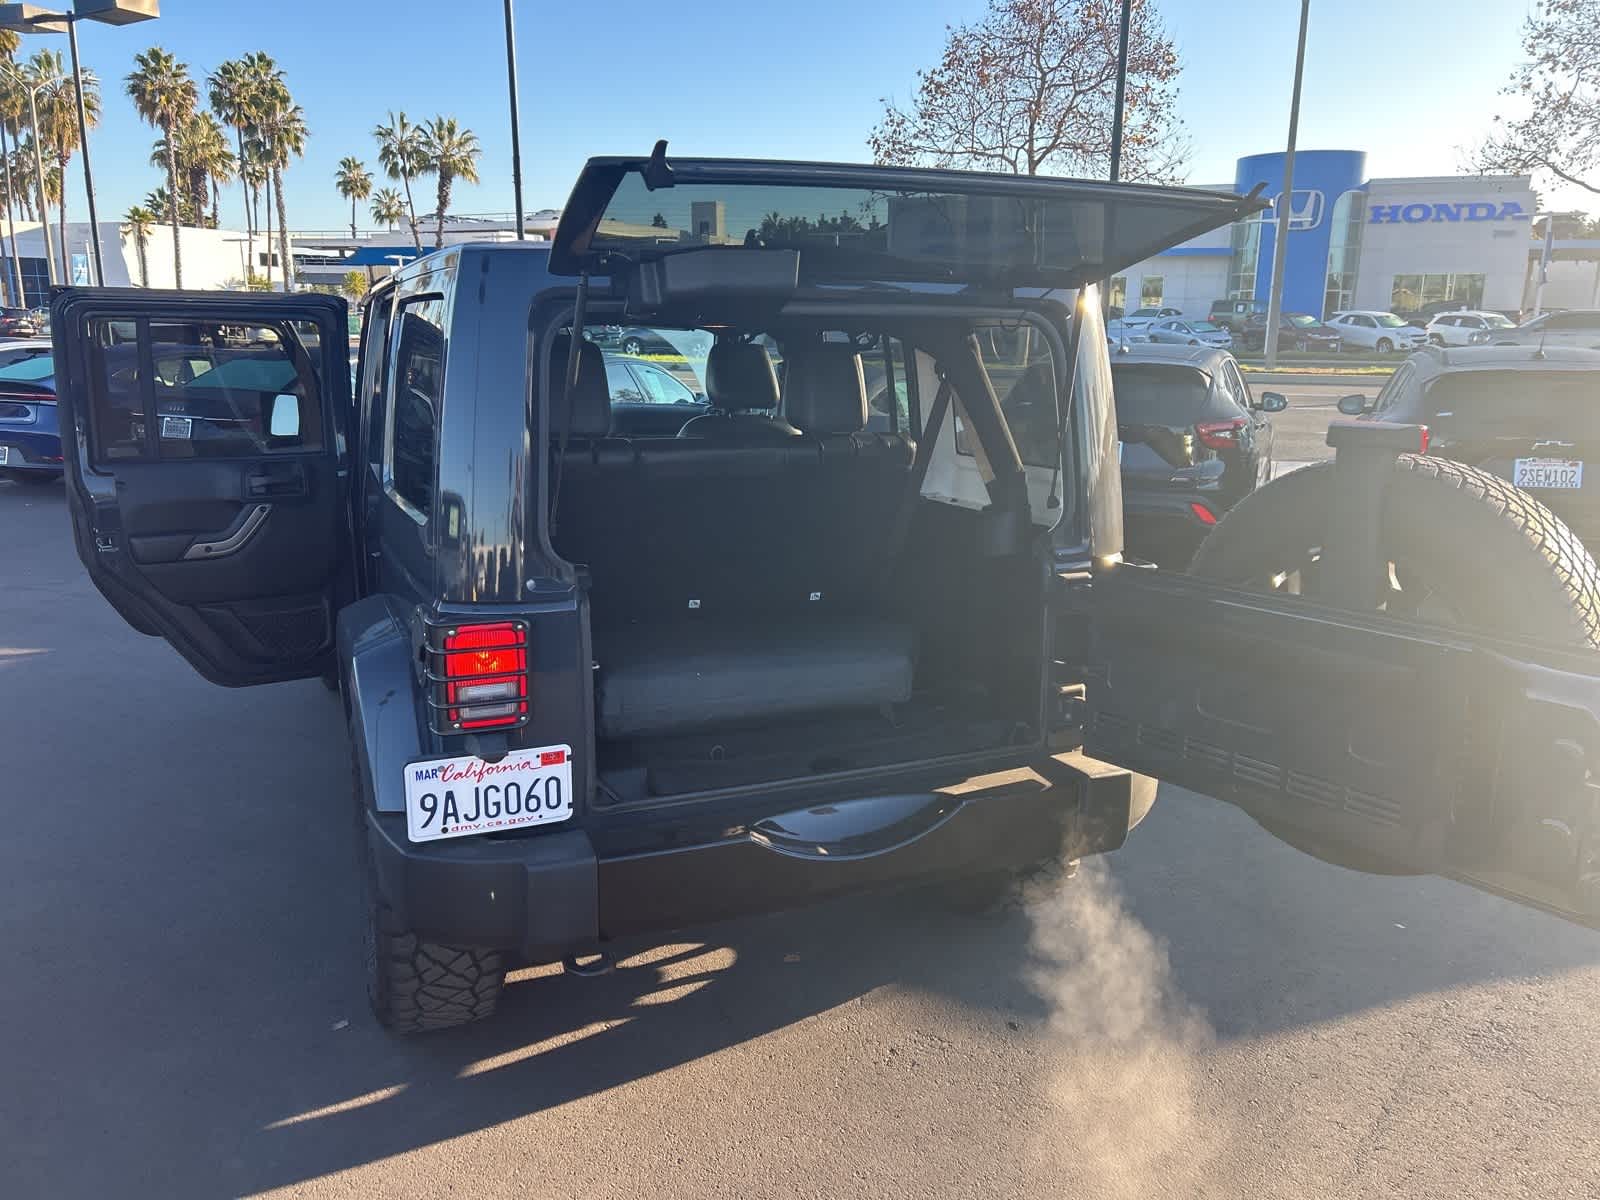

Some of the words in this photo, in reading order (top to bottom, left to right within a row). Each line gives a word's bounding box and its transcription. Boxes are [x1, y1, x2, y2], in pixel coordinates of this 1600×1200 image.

[1369, 202, 1529, 224] HONDA
[1519, 468, 1577, 483] 9SEW102
[415, 770, 438, 781] MAR
[441, 760, 541, 783] California
[420, 775, 562, 829] 9AJG060
[451, 815, 534, 832] dmv.ca.gov
